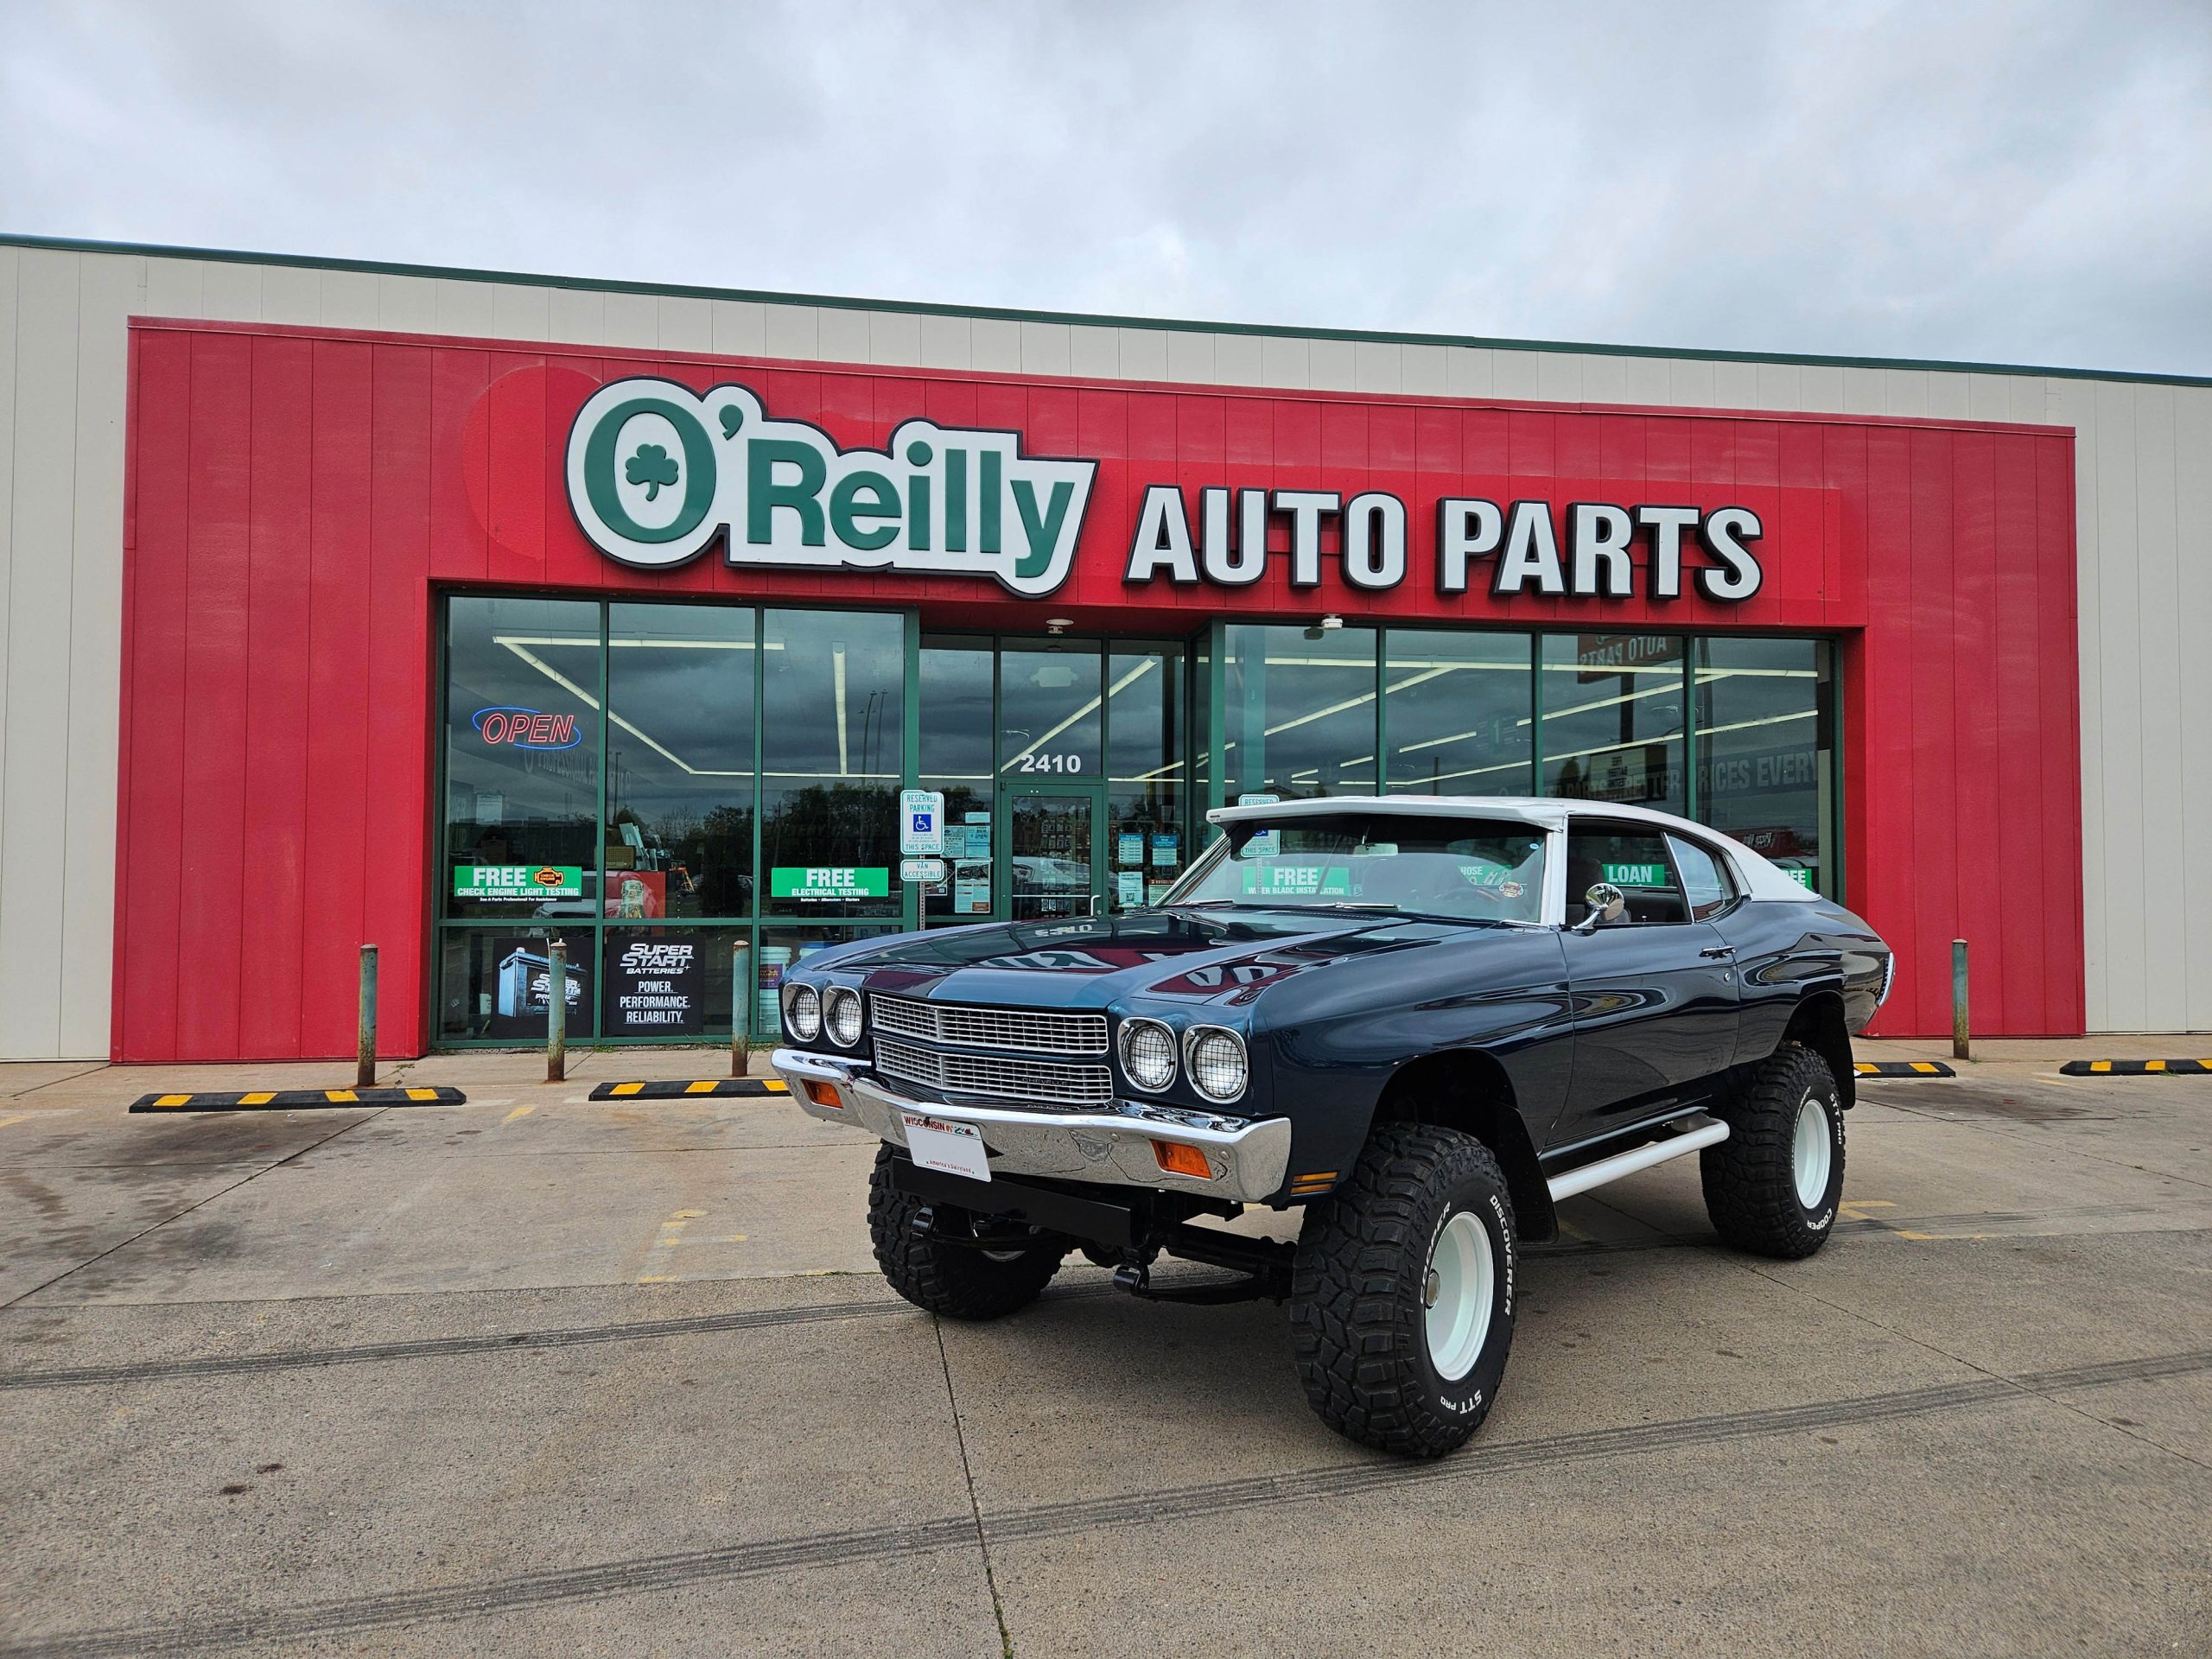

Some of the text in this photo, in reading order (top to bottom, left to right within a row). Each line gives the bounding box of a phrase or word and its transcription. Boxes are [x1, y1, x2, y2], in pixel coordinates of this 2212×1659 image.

[584, 397, 1074, 577] O'Reilly
[1125, 485, 1763, 601] AUTO PARTS
[482, 713, 575, 744] OPEN
[1020, 754, 1081, 773] 2410
[1697, 760, 1750, 793] RICES
[907, 794, 938, 803] RESERVED
[473, 868, 526, 887] FREE
[806, 868, 855, 887] FREE
[1274, 868, 1318, 886] FREE
[1460, 866, 1483, 875] HOSE
[1608, 866, 1652, 883] LOAN
[457, 887, 579, 896] CHECK ENGINE LIGHT TESTING
[1296, 887, 1344, 895] INSTALATION
[629, 943, 693, 956] SUPER
[620, 953, 693, 967] START
[638, 981, 674, 993] POWER.
[620, 995, 691, 1008] PERFORMANCE.
[626, 1010, 683, 1023] RELIABILITY.
[1022, 1077, 1067, 1086] CHEVELLE
[904, 1116, 945, 1132] WISCONSIN
[1807, 1208, 1833, 1230] COOPER
[1420, 1201, 1451, 1305] COOPER
[1489, 1194, 1512, 1316] DISCOVERER
[1440, 1389, 1483, 1414] STT PRO
